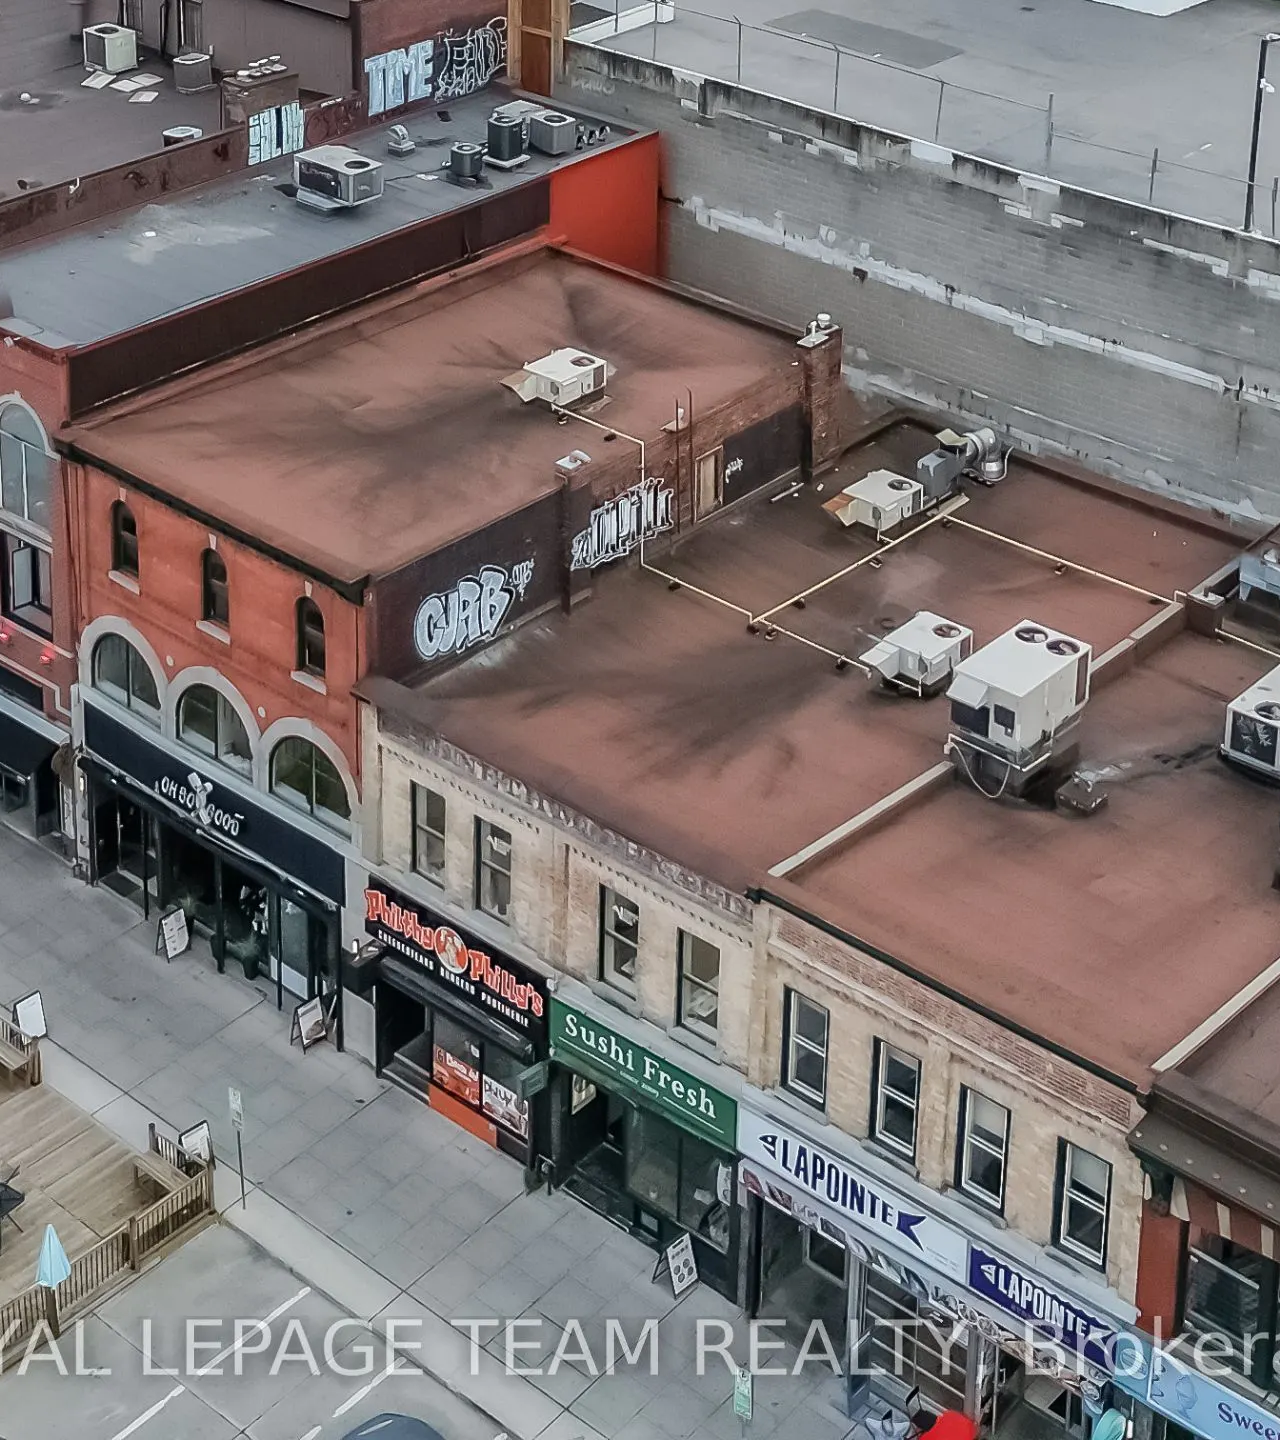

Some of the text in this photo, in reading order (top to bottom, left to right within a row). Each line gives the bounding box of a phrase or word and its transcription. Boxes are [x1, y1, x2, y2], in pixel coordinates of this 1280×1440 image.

[161, 776, 178, 799] OH
[364, 889, 543, 1017] Philthy Philly's
[565, 1014, 634, 1071] Sushi
[643, 1055, 716, 1118] Fresh
[781, 1138, 894, 1227] LAPOINTE
[998, 1267, 1088, 1337] LAPOINTE
